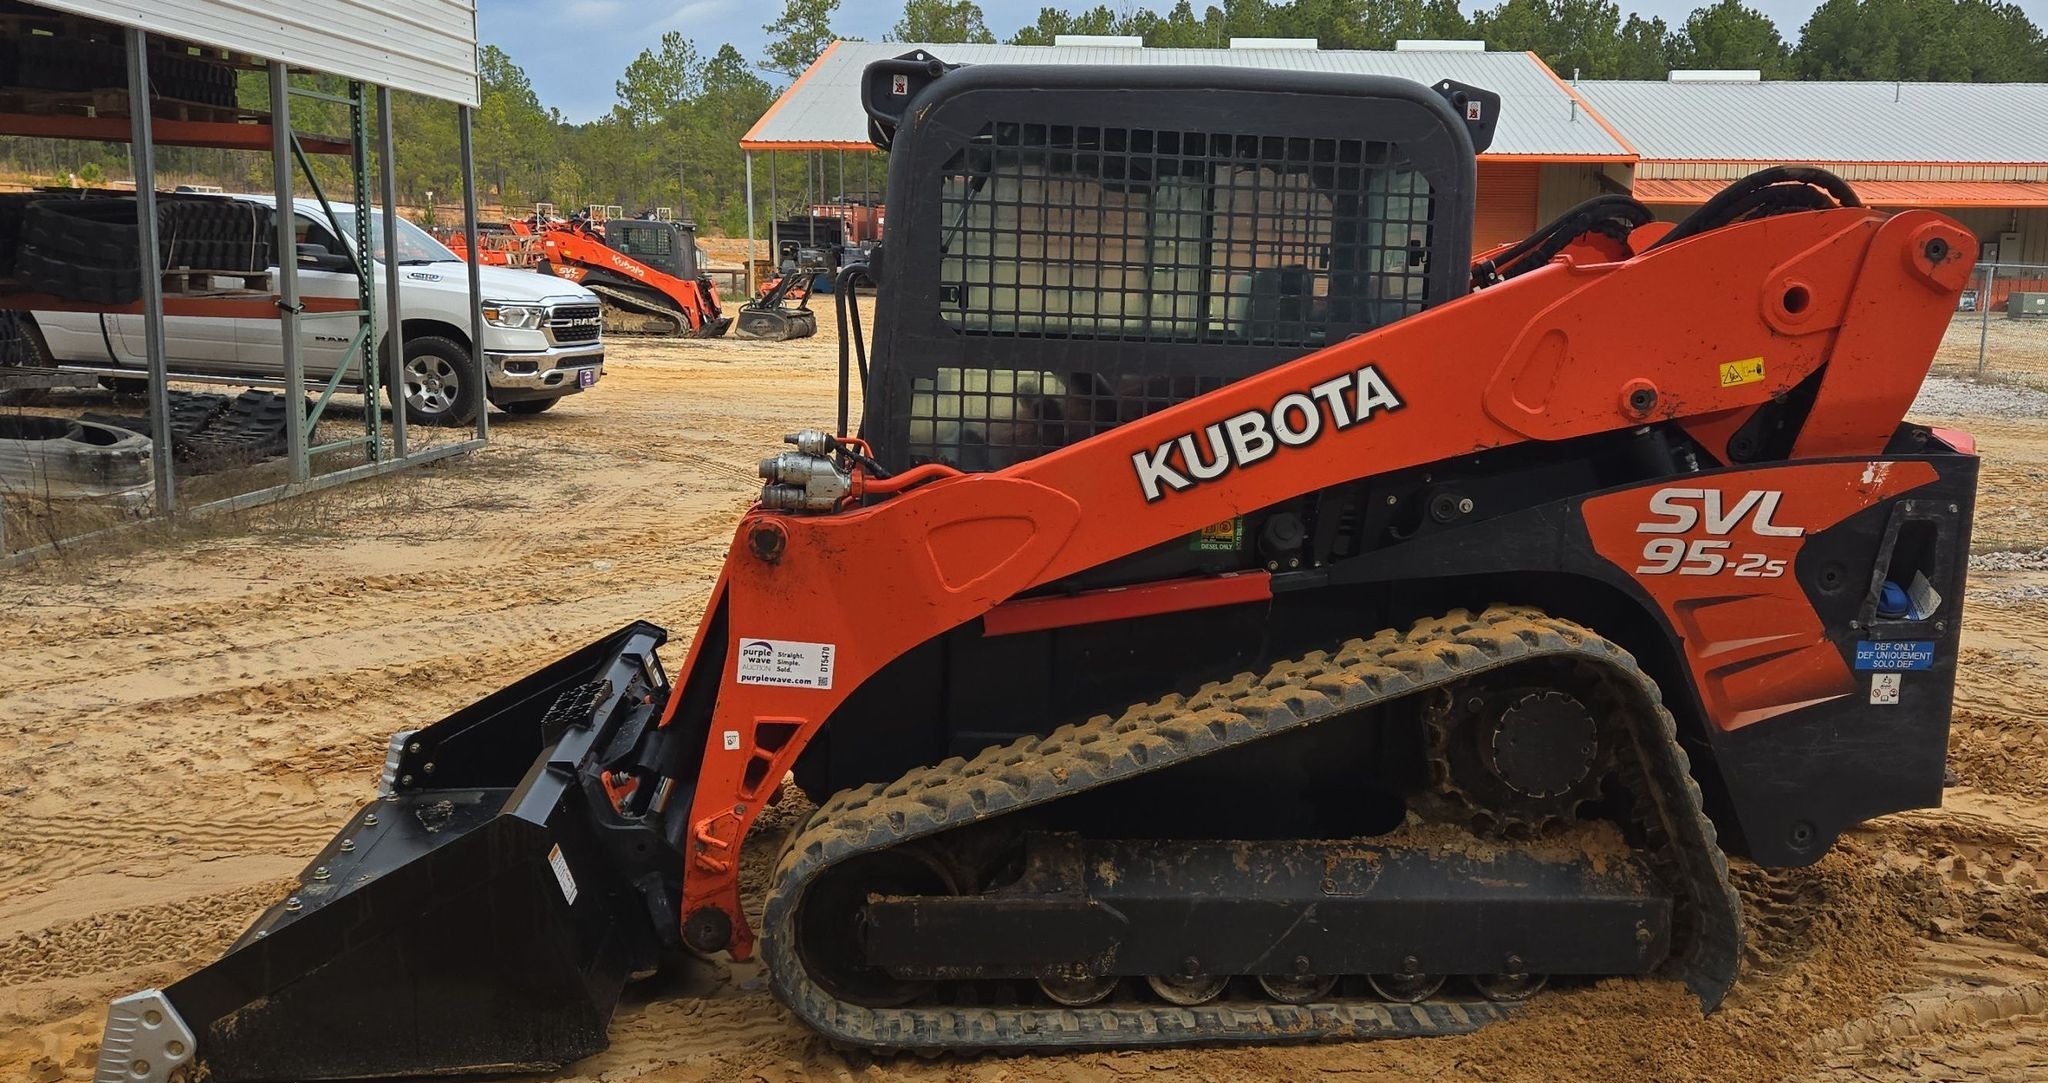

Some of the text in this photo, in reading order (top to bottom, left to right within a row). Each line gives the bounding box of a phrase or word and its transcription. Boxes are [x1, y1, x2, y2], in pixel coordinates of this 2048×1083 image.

[612, 255, 645, 277] Kubota
[559, 267, 579, 275] SVL
[574, 317, 597, 326] RAM
[1131, 364, 1402, 502] KUBOTA
[1636, 488, 1805, 537] SVL
[1874, 643, 1917, 652] DEF ONLY
[743, 648, 772, 657] purple
[777, 651, 805, 660] Straight.
[1857, 651, 1932, 661] DEF UNIQUEMENT
[748, 657, 771, 665] wave
[777, 659, 801, 667] Simple.
[1872, 660, 1914, 668] SOLO DEF
[742, 664, 772, 672] AUCTION
[741, 674, 812, 685] purplewave.com
